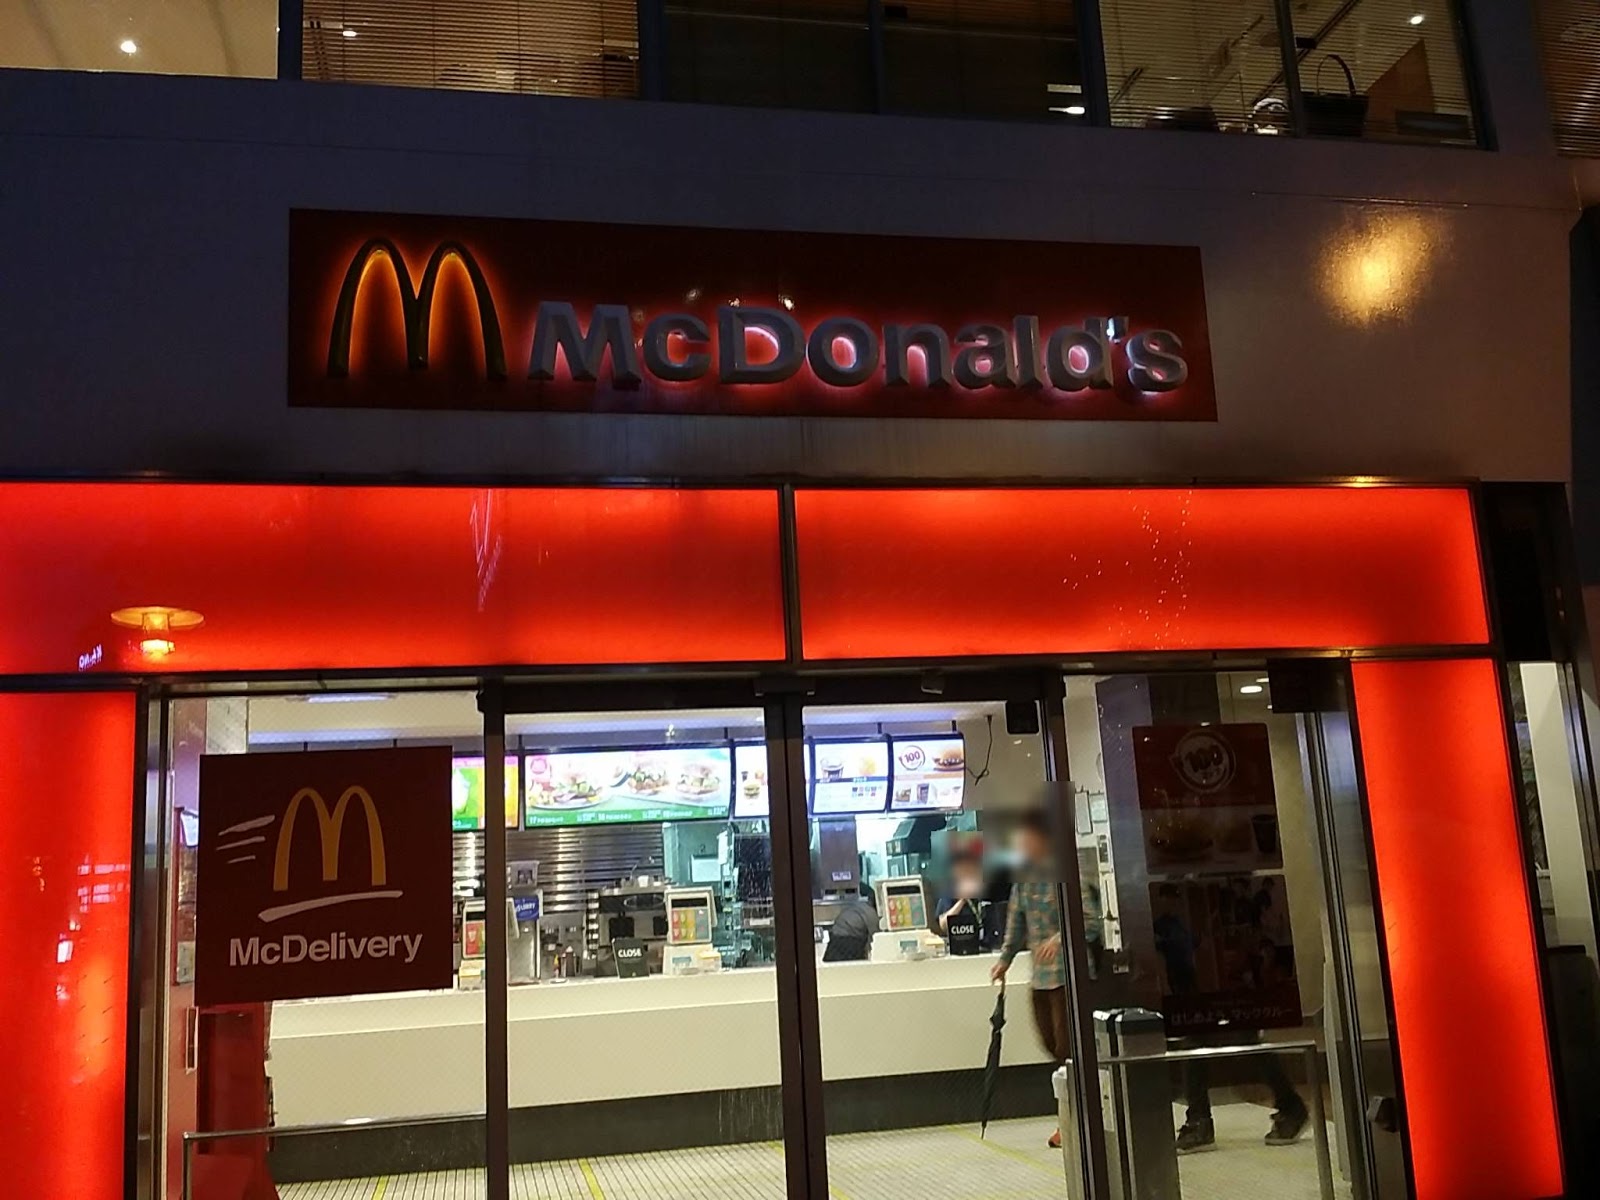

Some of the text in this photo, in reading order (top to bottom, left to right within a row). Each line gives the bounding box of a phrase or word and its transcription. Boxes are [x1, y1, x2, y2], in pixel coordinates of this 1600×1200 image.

[528, 301, 1188, 392] McDonald's
[950, 925, 975, 935] CLOSE
[229, 931, 423, 967] McDelivery
[617, 947, 643, 958] CLOSE
